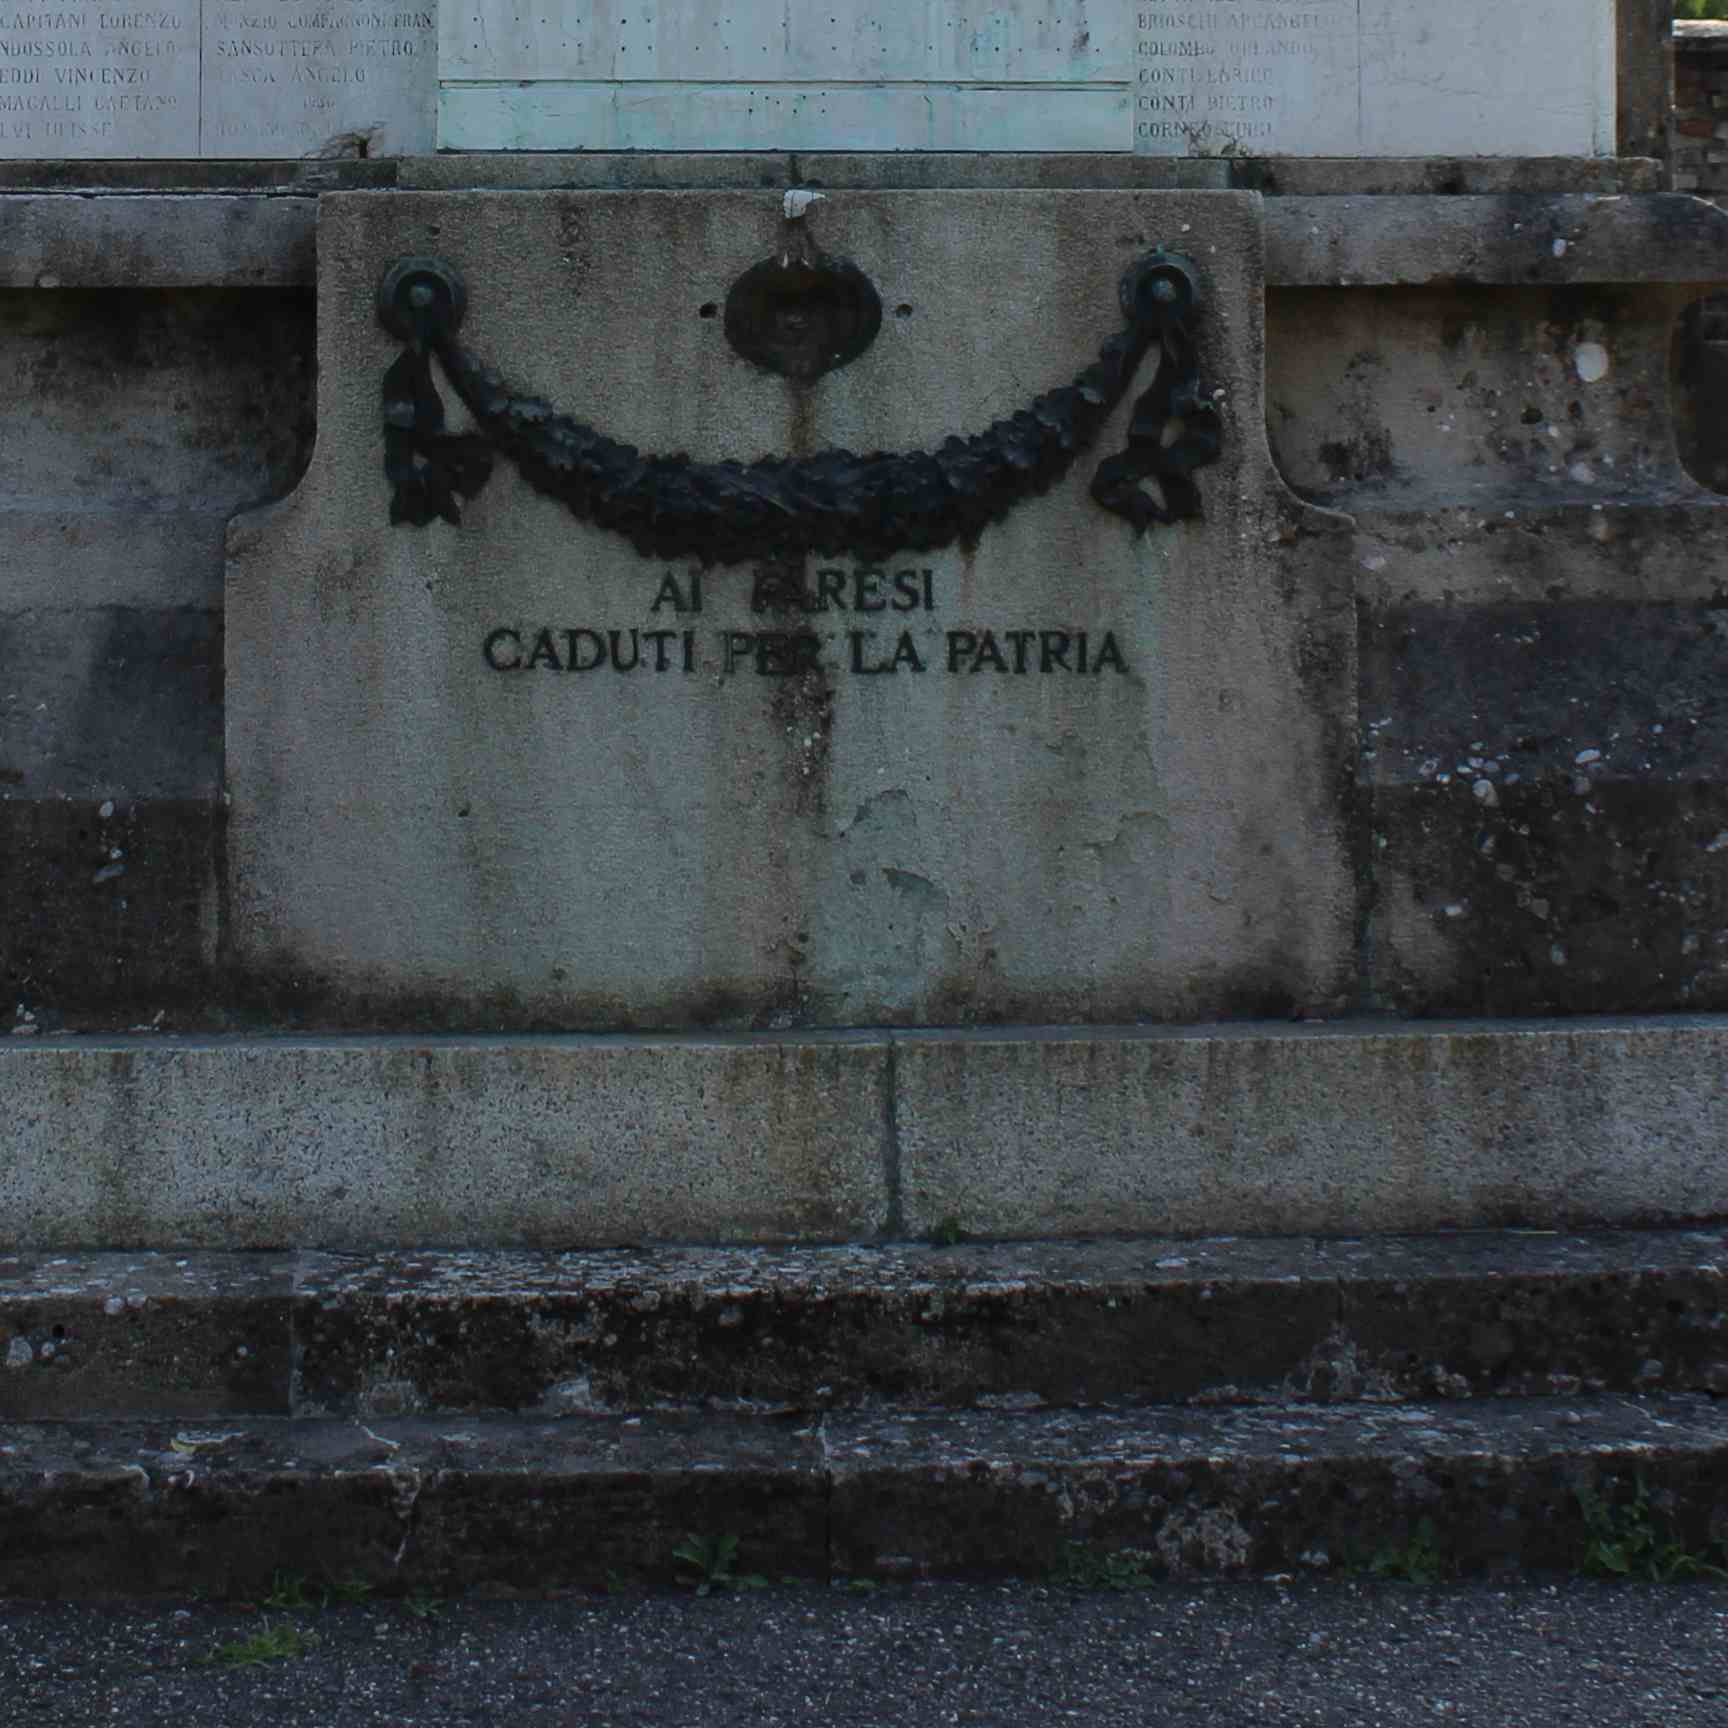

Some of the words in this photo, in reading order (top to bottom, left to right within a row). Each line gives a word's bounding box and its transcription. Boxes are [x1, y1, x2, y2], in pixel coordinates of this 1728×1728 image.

[54, 68, 152, 85] VINCENZO
[650, 568, 702, 613] AI
[481, 626, 695, 674] CADUTI
[725, 626, 823, 674] PER
[849, 626, 926, 674] LA
[945, 626, 1129, 674] PATRIA
